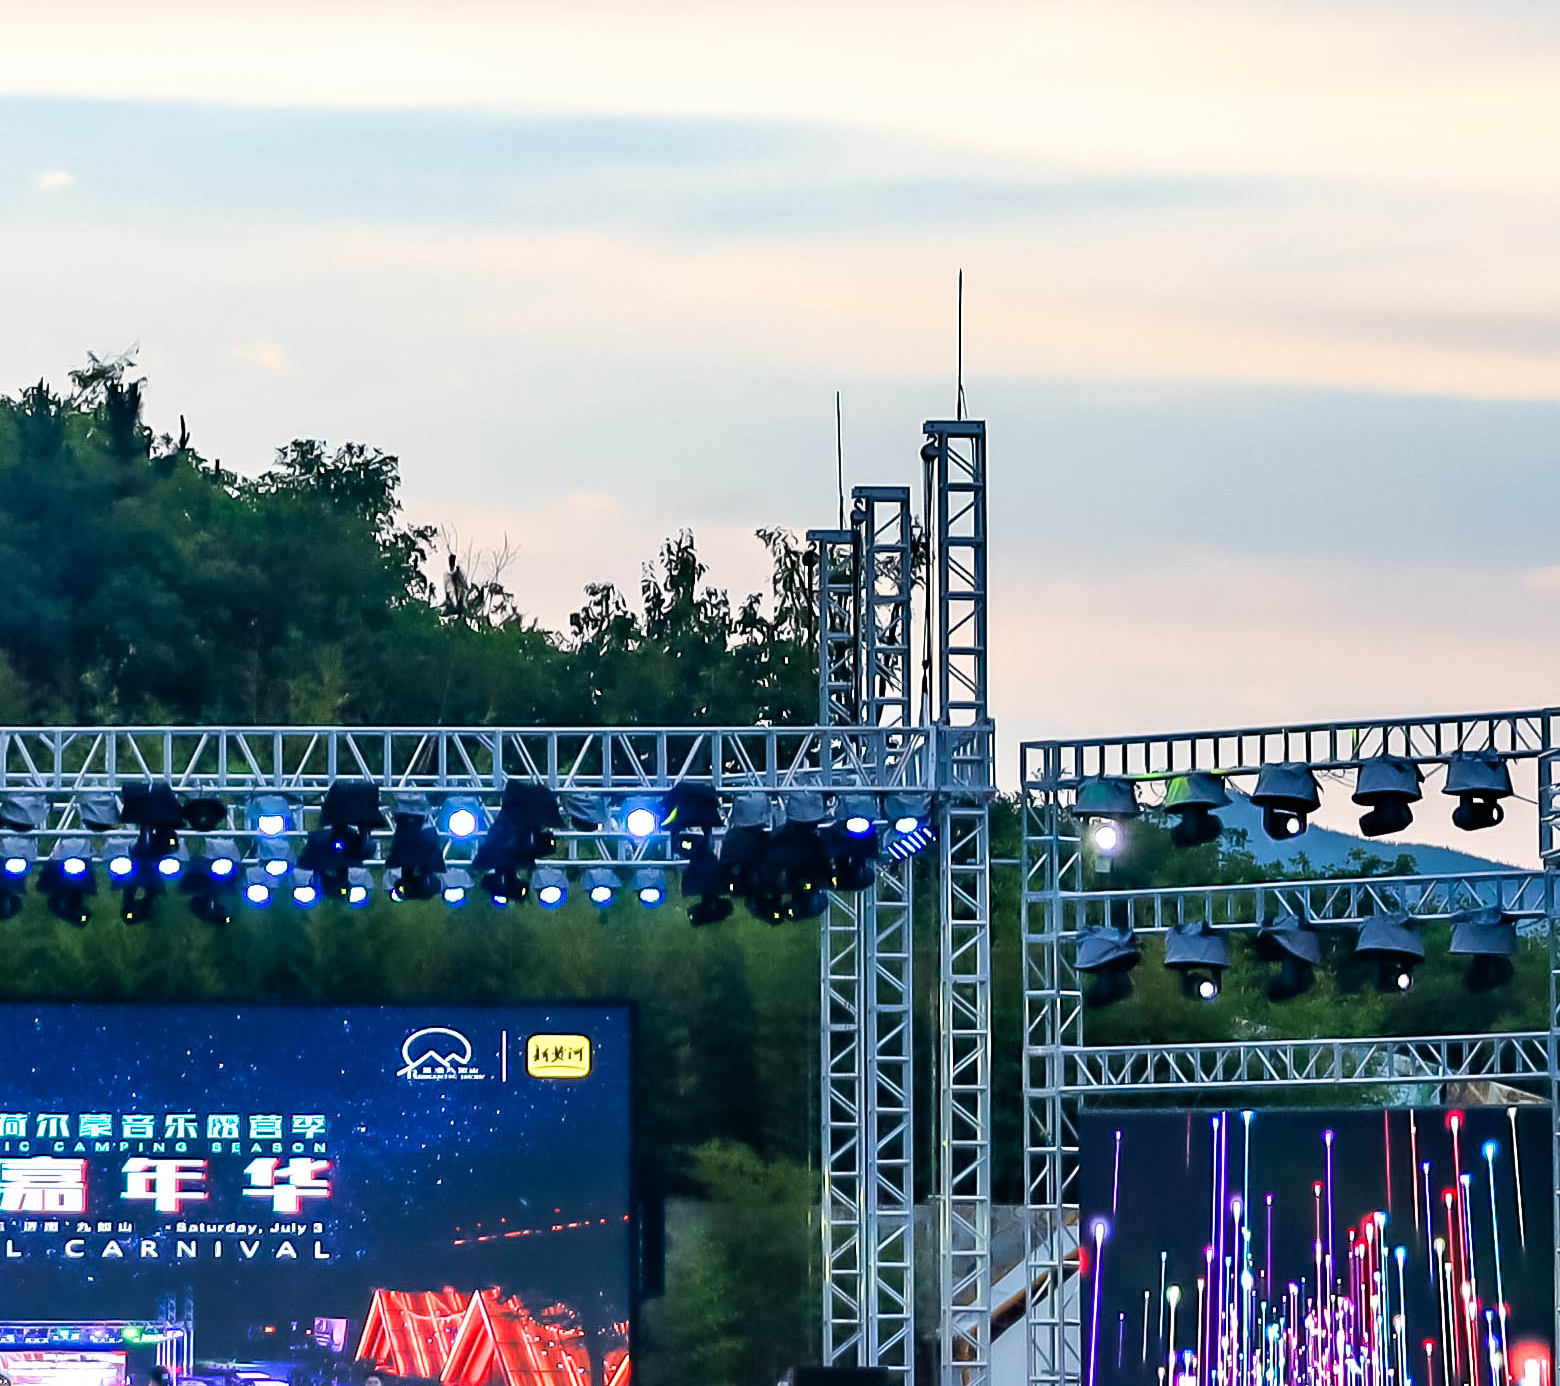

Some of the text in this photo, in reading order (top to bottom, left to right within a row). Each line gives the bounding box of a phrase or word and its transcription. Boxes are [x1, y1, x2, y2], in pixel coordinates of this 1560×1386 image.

[53, 1141, 187, 1153] CAMPING
[211, 1142, 326, 1154] SEASON
[269, 1222, 307, 1235] July
[63, 1239, 331, 1260] CARNIVAL
